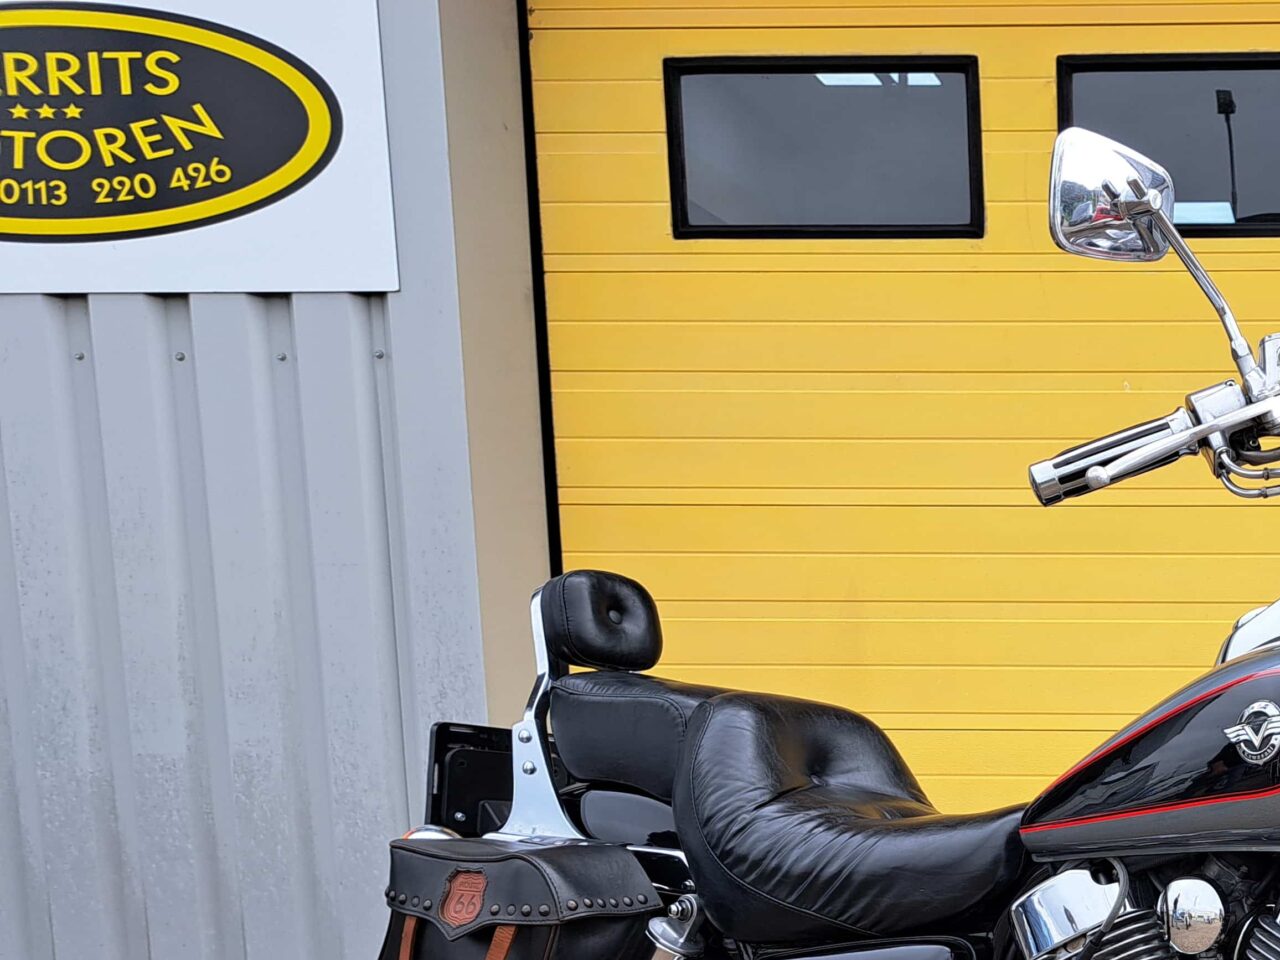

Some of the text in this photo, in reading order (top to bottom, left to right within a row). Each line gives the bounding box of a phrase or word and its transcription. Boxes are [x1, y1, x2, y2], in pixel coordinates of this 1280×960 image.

[0, 50, 182, 96] RRITS
[0, 103, 225, 170] TOREN
[0, 156, 232, 206] 0113 220 426
[453, 893, 477, 915] 66
